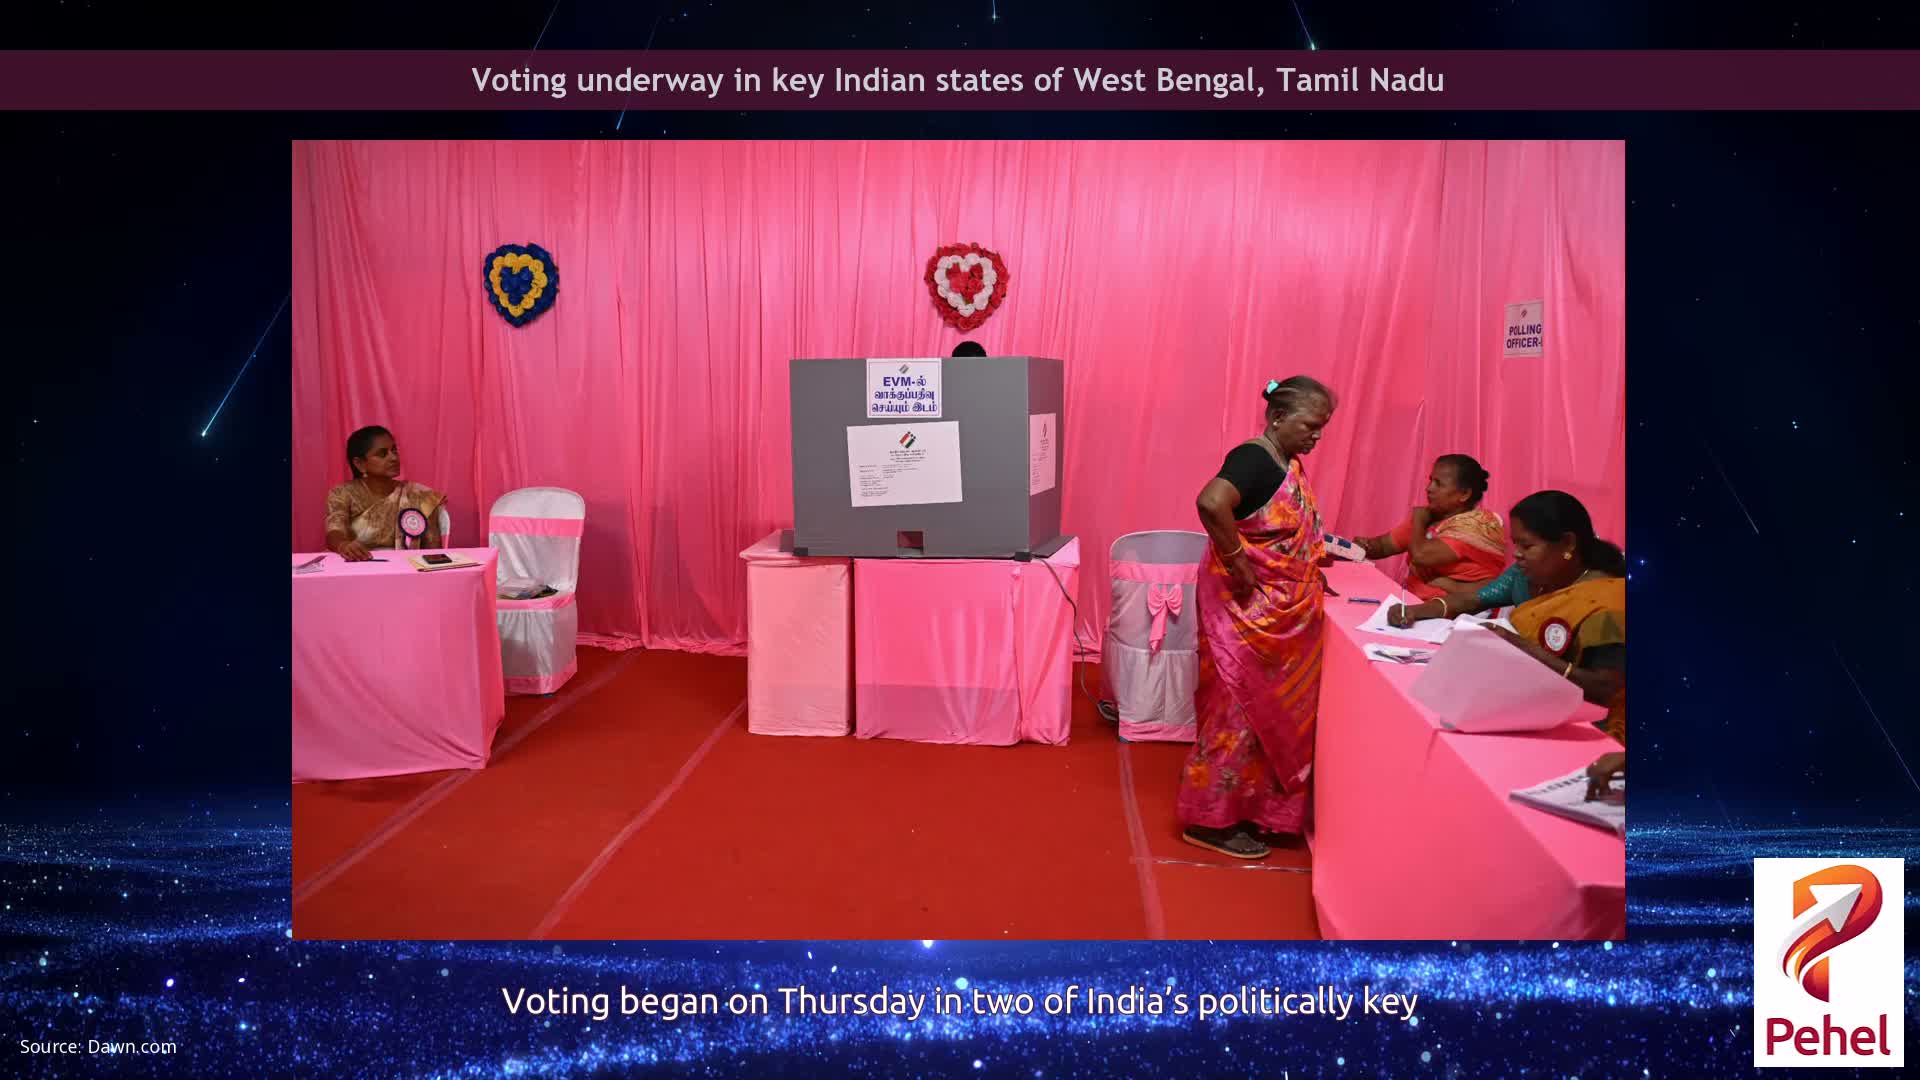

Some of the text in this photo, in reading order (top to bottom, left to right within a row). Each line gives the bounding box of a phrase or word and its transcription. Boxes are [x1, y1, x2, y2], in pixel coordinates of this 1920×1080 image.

[1509, 324, 1542, 336] POLLING
[883, 375, 927, 387] EVM-ல்
[874, 387, 935, 401] வாக்குப்பதிவு
[872, 400, 938, 414] செய்யும் இடம்
